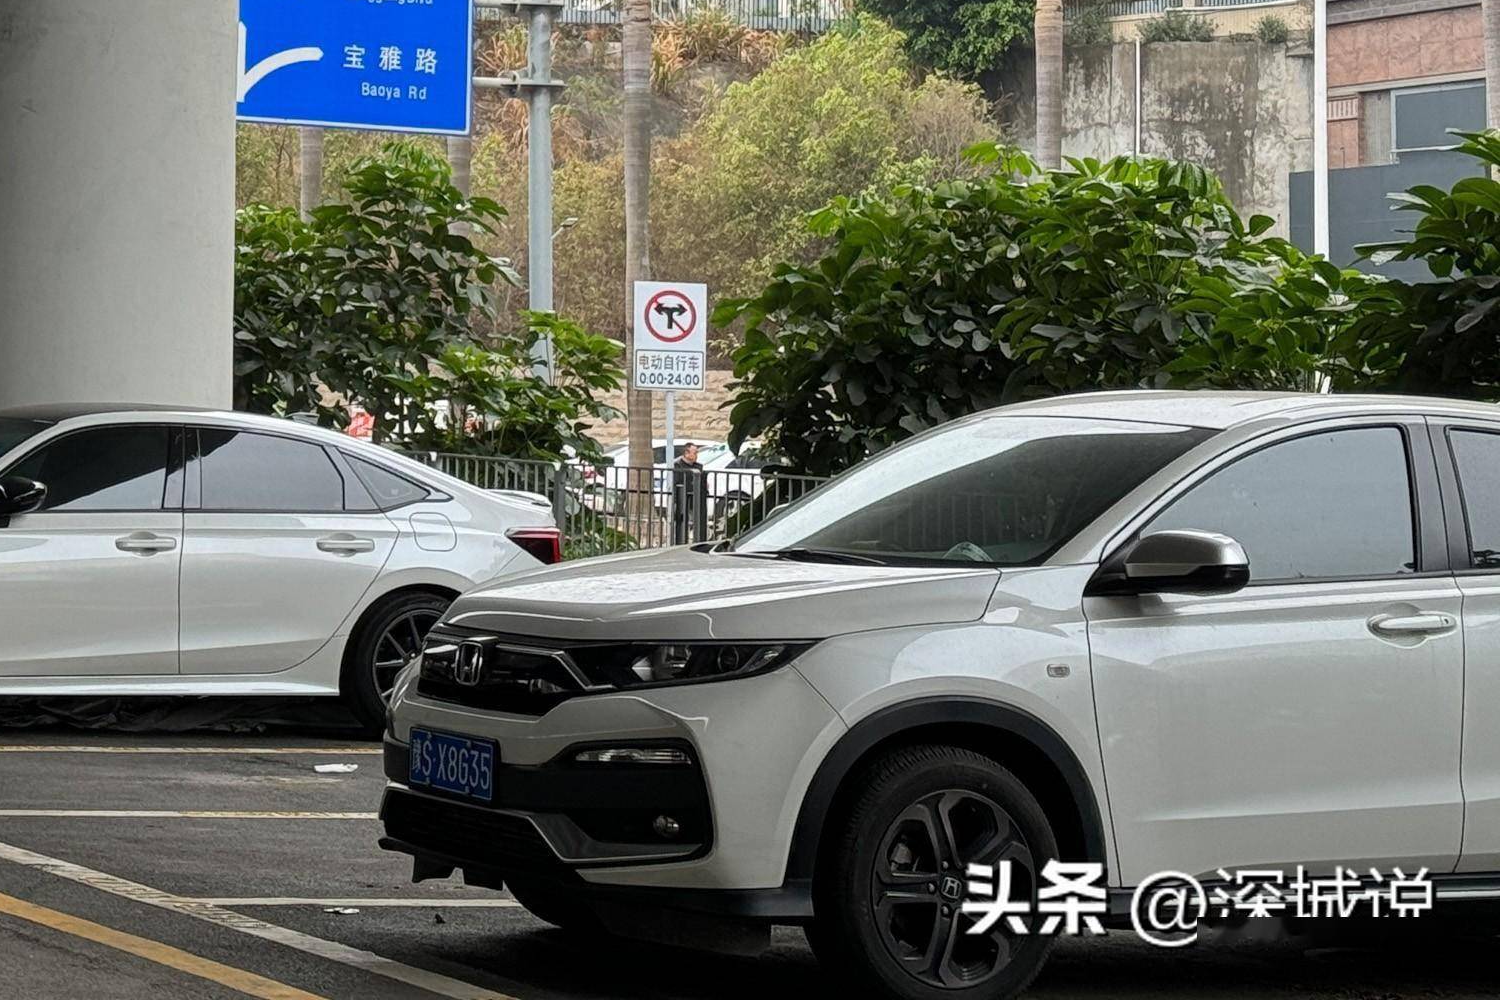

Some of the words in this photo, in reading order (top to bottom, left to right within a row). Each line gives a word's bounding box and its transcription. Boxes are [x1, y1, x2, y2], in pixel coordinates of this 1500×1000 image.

[343, 44, 438, 75] 宝雅路
[361, 82, 400, 100] Baoya
[408, 84, 427, 100] Rd
[639, 355, 700, 371] 电动自行车
[639, 373, 700, 386] 0:00-24:00
